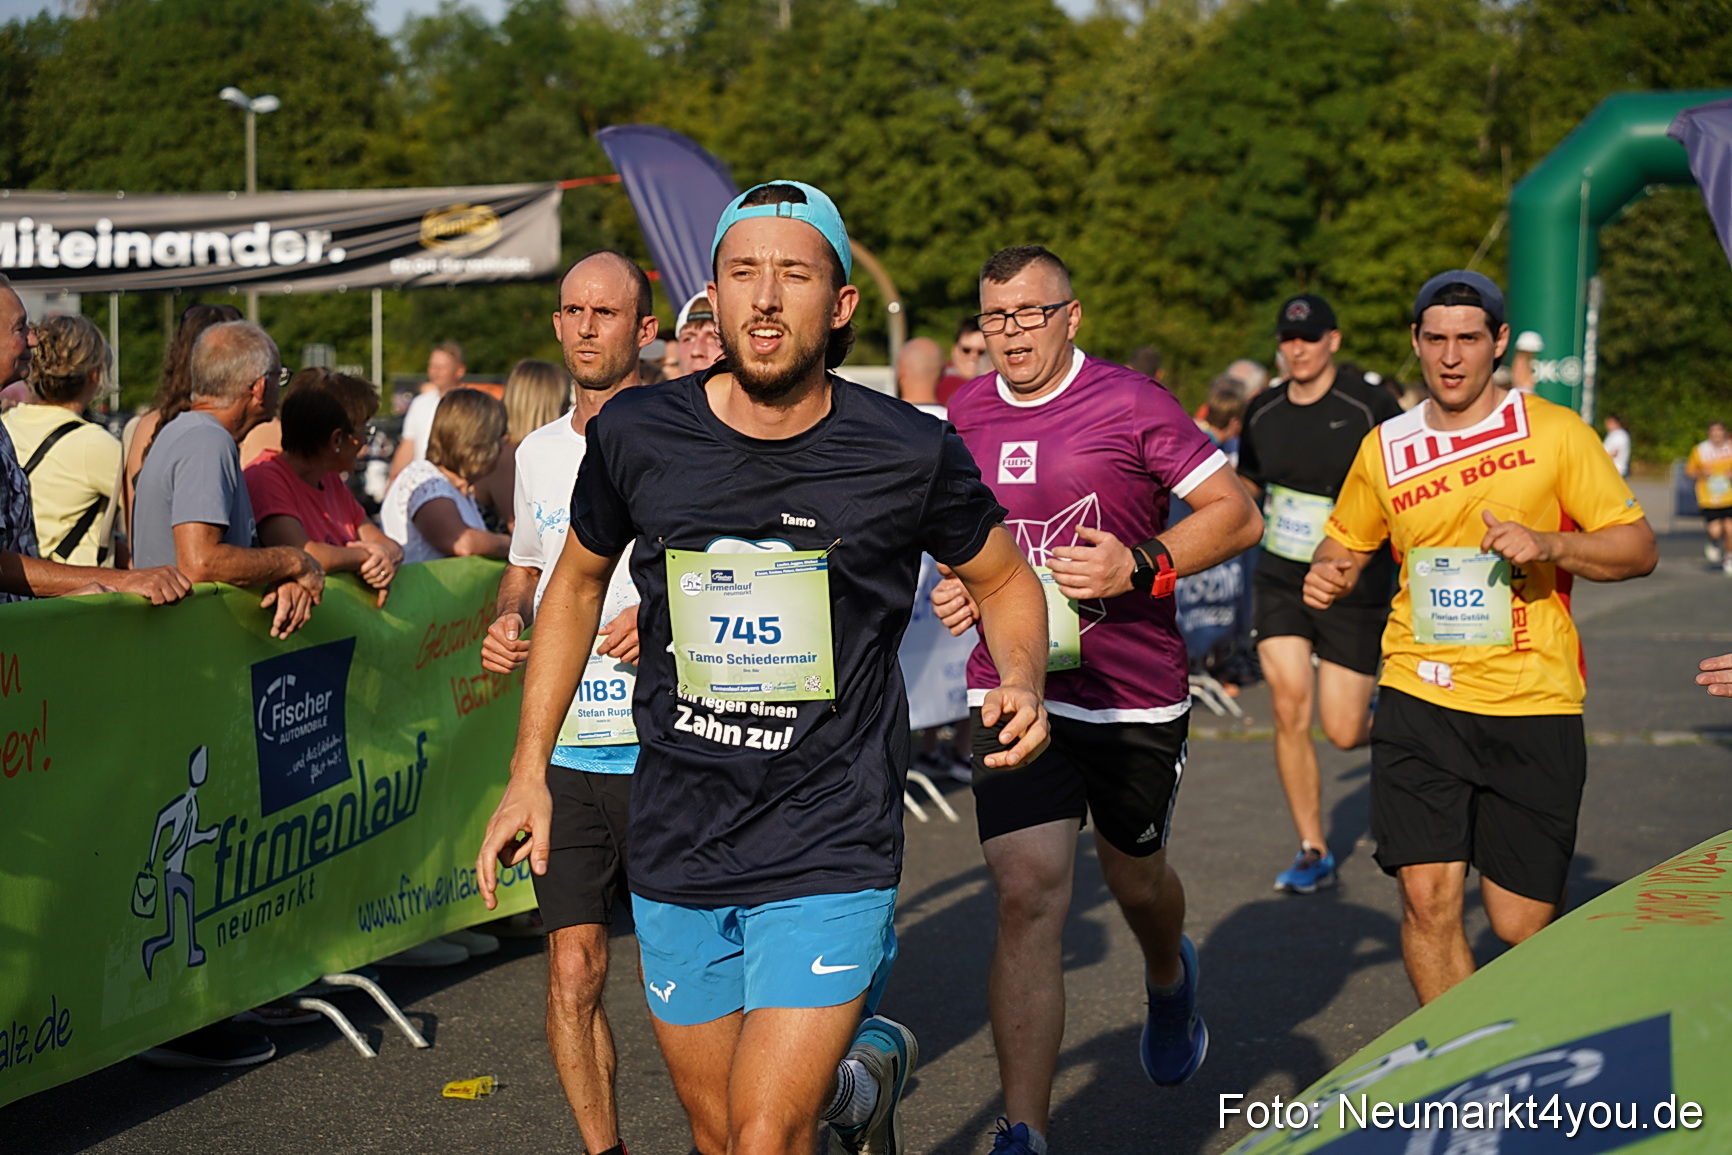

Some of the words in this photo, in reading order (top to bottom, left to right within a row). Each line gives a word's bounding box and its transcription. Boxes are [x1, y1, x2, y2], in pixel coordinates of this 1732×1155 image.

[1002, 458, 1033, 466] FUCHS
[1391, 476, 1452, 514] MAX
[1460, 449, 1535, 487] BÖGL
[781, 513, 816, 528] Tamo
[705, 582, 752, 591] Firmenlauf
[1430, 589, 1485, 608] 1682
[1431, 612, 1458, 621] Florian
[710, 616, 782, 645] 745
[687, 650, 723, 664] Tamo
[726, 651, 817, 665] Schiedermair
[578, 679, 627, 702] 1183
[272, 689, 333, 732] Fischer
[578, 708, 605, 718] Stefan
[607, 708, 633, 718] Rupp
[750, 701, 798, 719] einen
[279, 715, 328, 745] AUTOMOBILE
[674, 704, 742, 746] Zahn
[745, 726, 794, 750] zu!
[214, 731, 428, 909] firmenlauf
[217, 873, 315, 947] neumarkt
